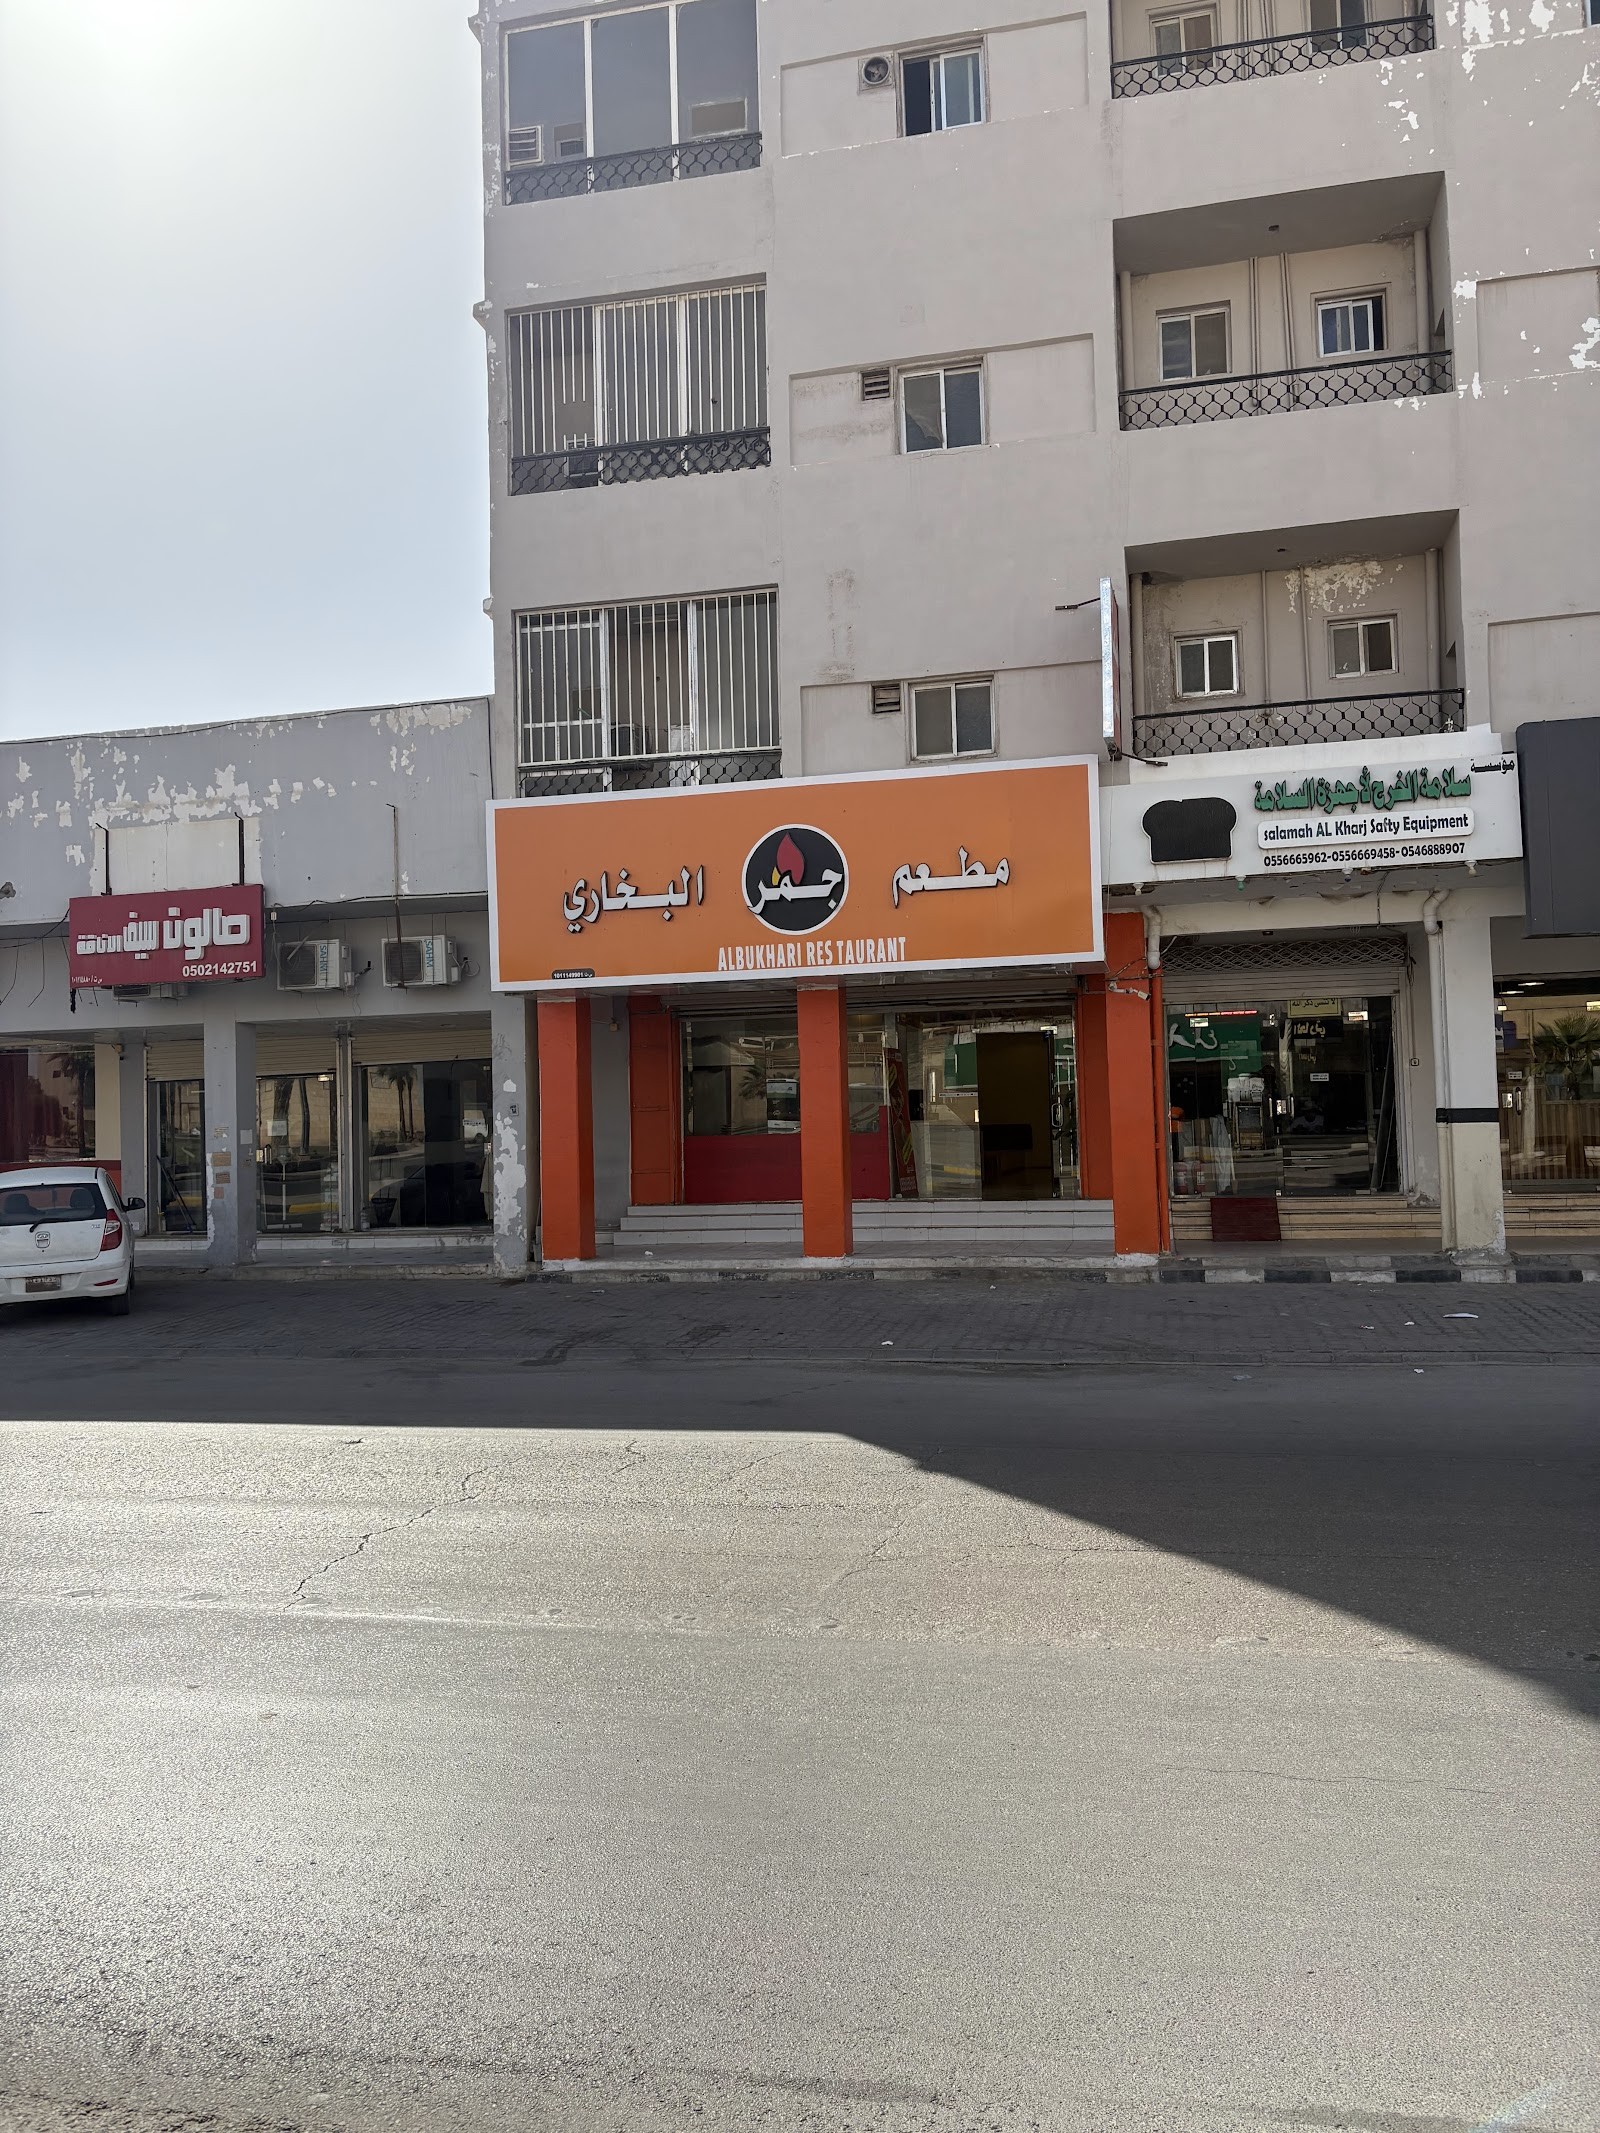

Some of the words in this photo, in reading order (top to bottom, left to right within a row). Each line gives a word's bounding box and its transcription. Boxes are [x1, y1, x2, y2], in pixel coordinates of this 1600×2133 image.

[1420, 765, 1472, 799] سلامة
[1470, 757, 1515, 775] مؤسسة
[1254, 776, 1315, 812] السلامة
[1372, 768, 1419, 811] الخرج
[1264, 823, 1313, 842] salamah
[1316, 822, 1333, 838] AL
[1335, 818, 1367, 838] Kharj
[1370, 816, 1401, 836] Safty
[1403, 813, 1469, 834] Equipment
[747, 868, 844, 915] جمر
[892, 845, 1011, 910] مطعم
[563, 864, 705, 934] البخاري
[163, 907, 250, 961] صالون
[182, 960, 257, 978] 0502142751
[718, 943, 802, 971] ALBUKHARI
